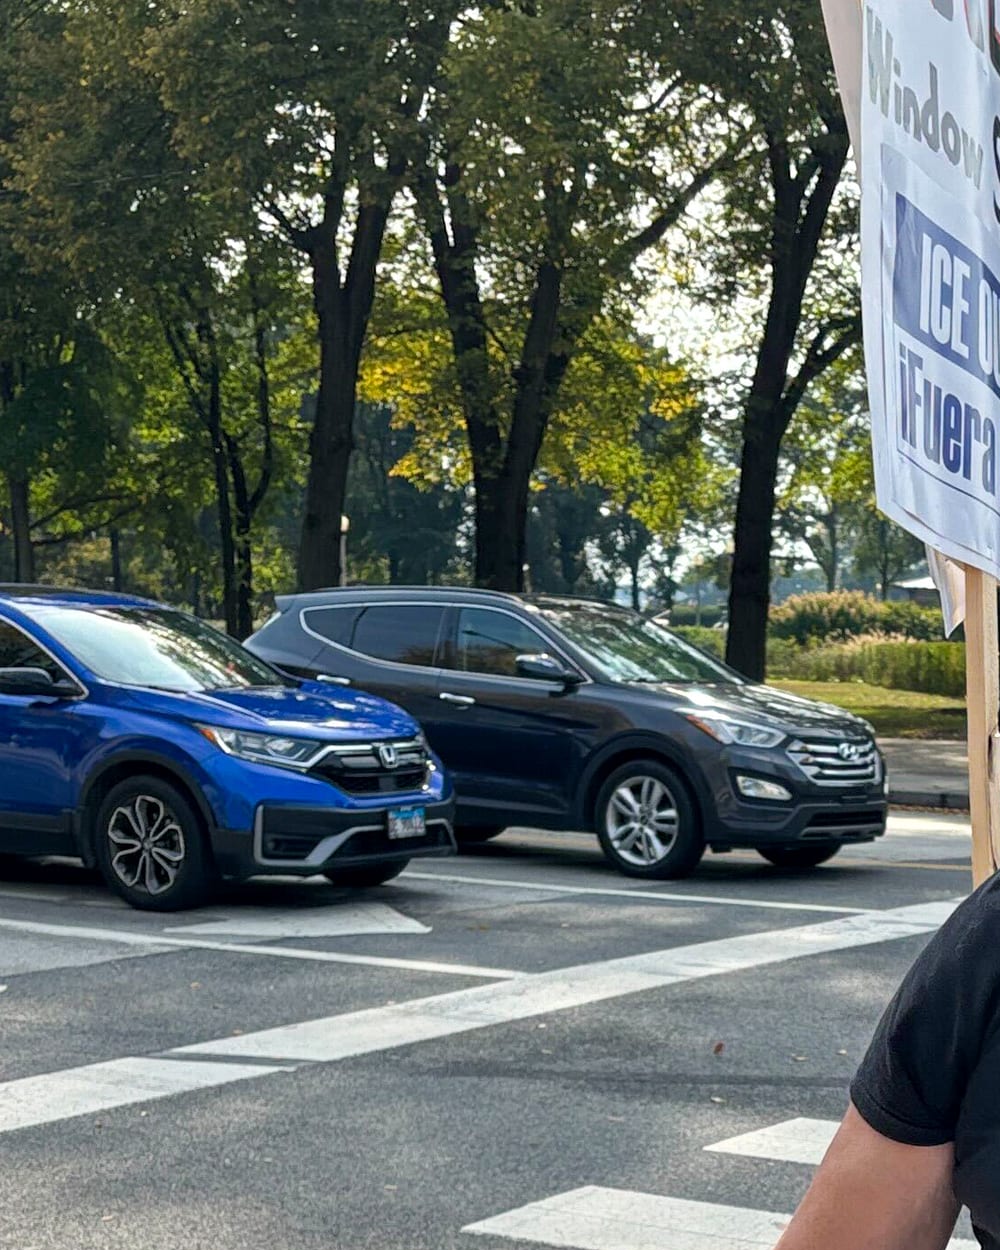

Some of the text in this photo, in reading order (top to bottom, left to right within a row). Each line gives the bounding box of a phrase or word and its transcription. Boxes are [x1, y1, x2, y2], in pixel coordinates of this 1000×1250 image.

[866, 4, 983, 190] Window
[919, 231, 970, 360] ICE
[900, 340, 995, 497] ¡Fuera
